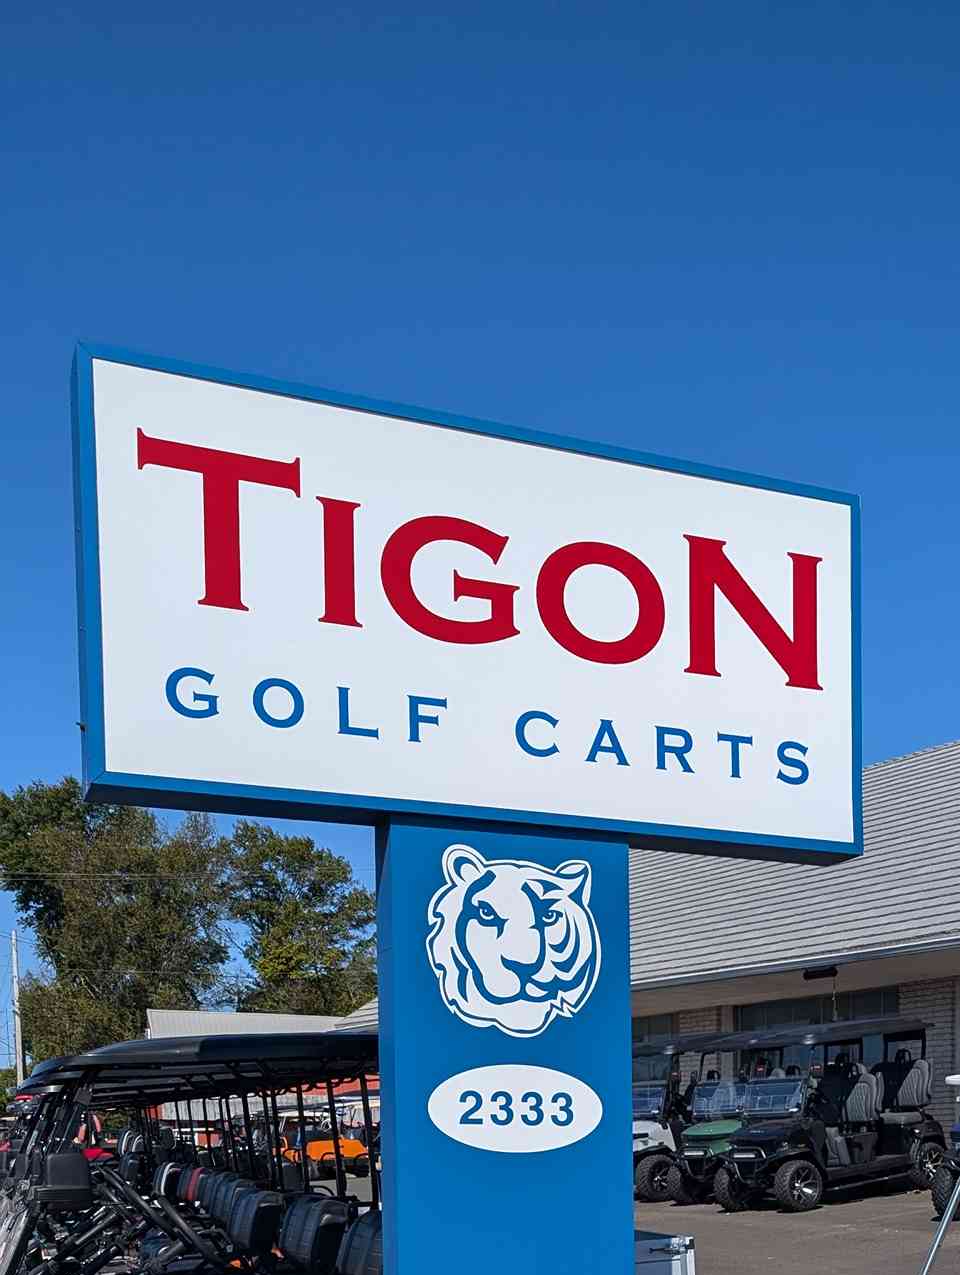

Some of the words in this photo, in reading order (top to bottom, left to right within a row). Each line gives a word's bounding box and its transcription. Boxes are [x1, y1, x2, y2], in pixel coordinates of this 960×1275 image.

[136, 428, 823, 690] TIGON
[166, 667, 447, 742] GOLF
[515, 711, 809, 785] CARTS
[459, 1089, 575, 1127] 2333
